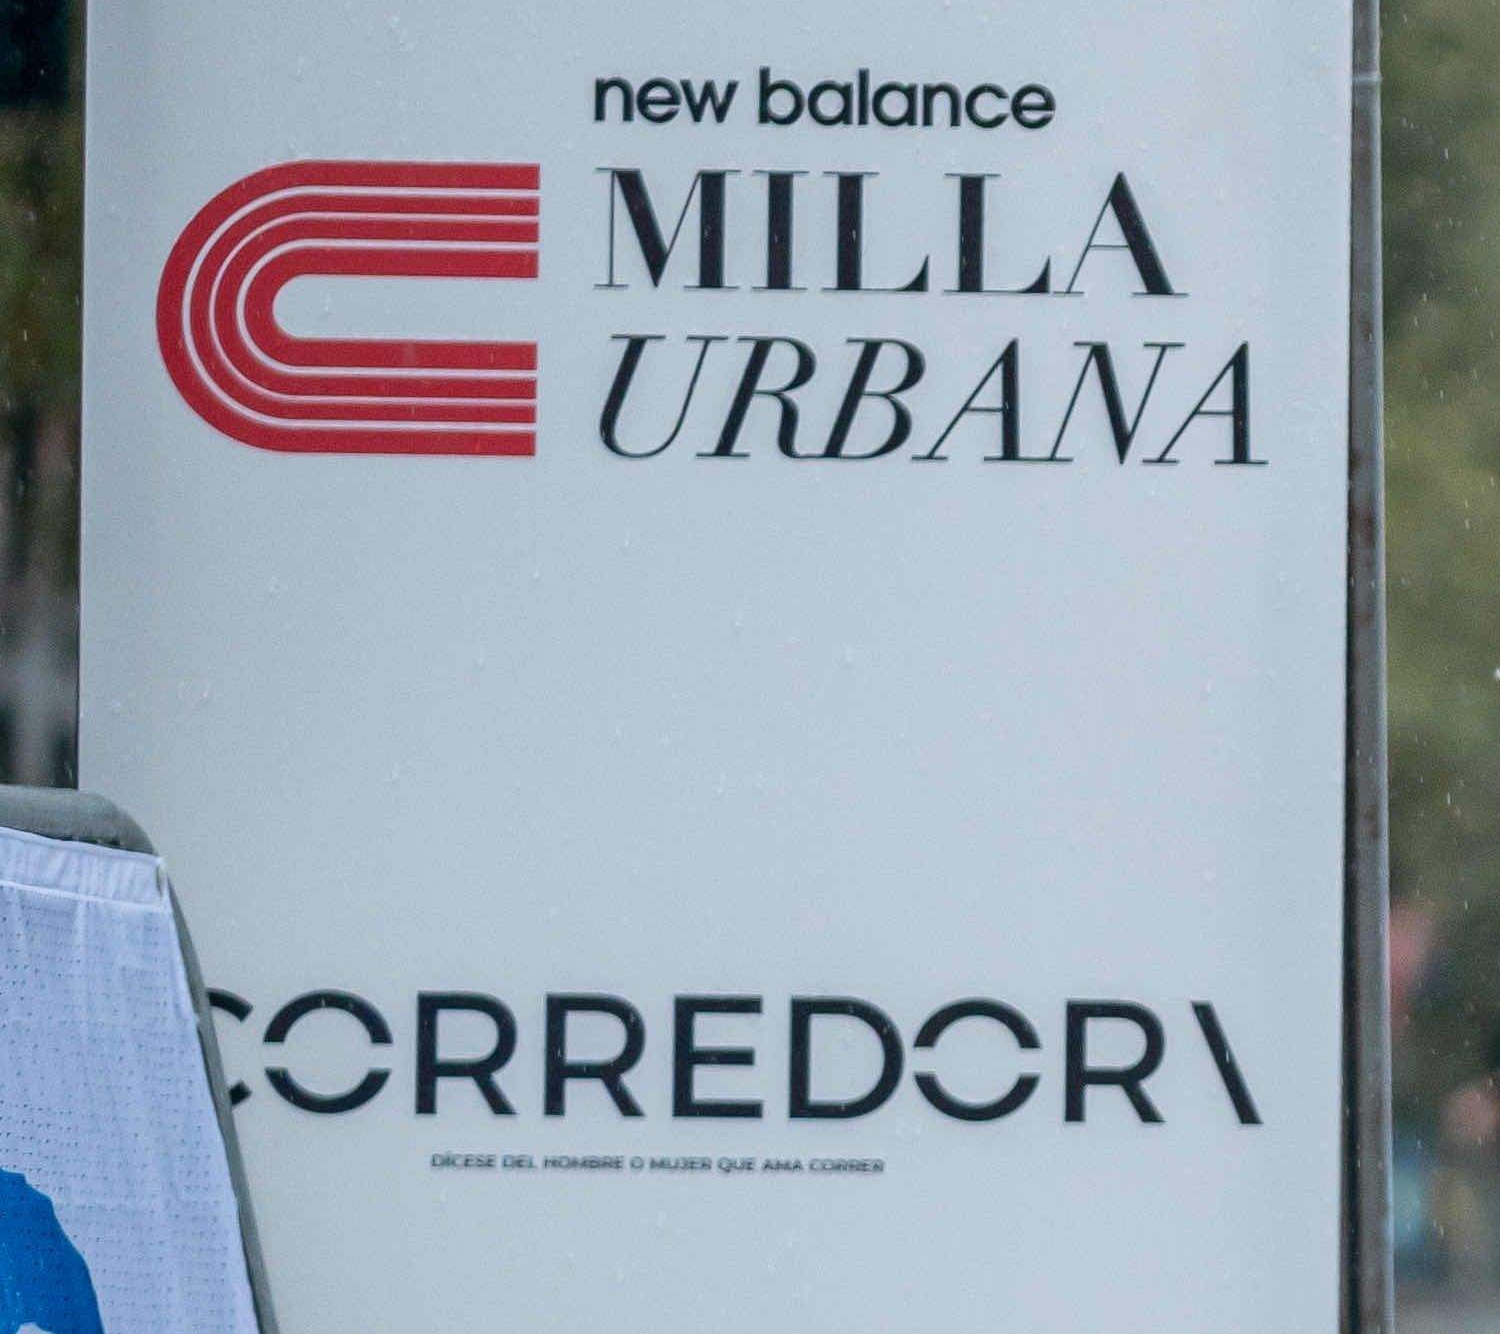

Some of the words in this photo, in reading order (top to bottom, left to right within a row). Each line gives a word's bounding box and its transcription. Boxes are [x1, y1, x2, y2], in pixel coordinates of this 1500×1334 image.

[594, 77, 739, 124] new
[758, 67, 1057, 130] balance
[594, 167, 1189, 298] MILLA
[598, 333, 1270, 466] URBANA
[503, 1154, 536, 1169] DEL
[544, 1155, 624, 1170] HOMBRE
[717, 1156, 757, 1173] QUE
[809, 1158, 884, 1173] CORRER
